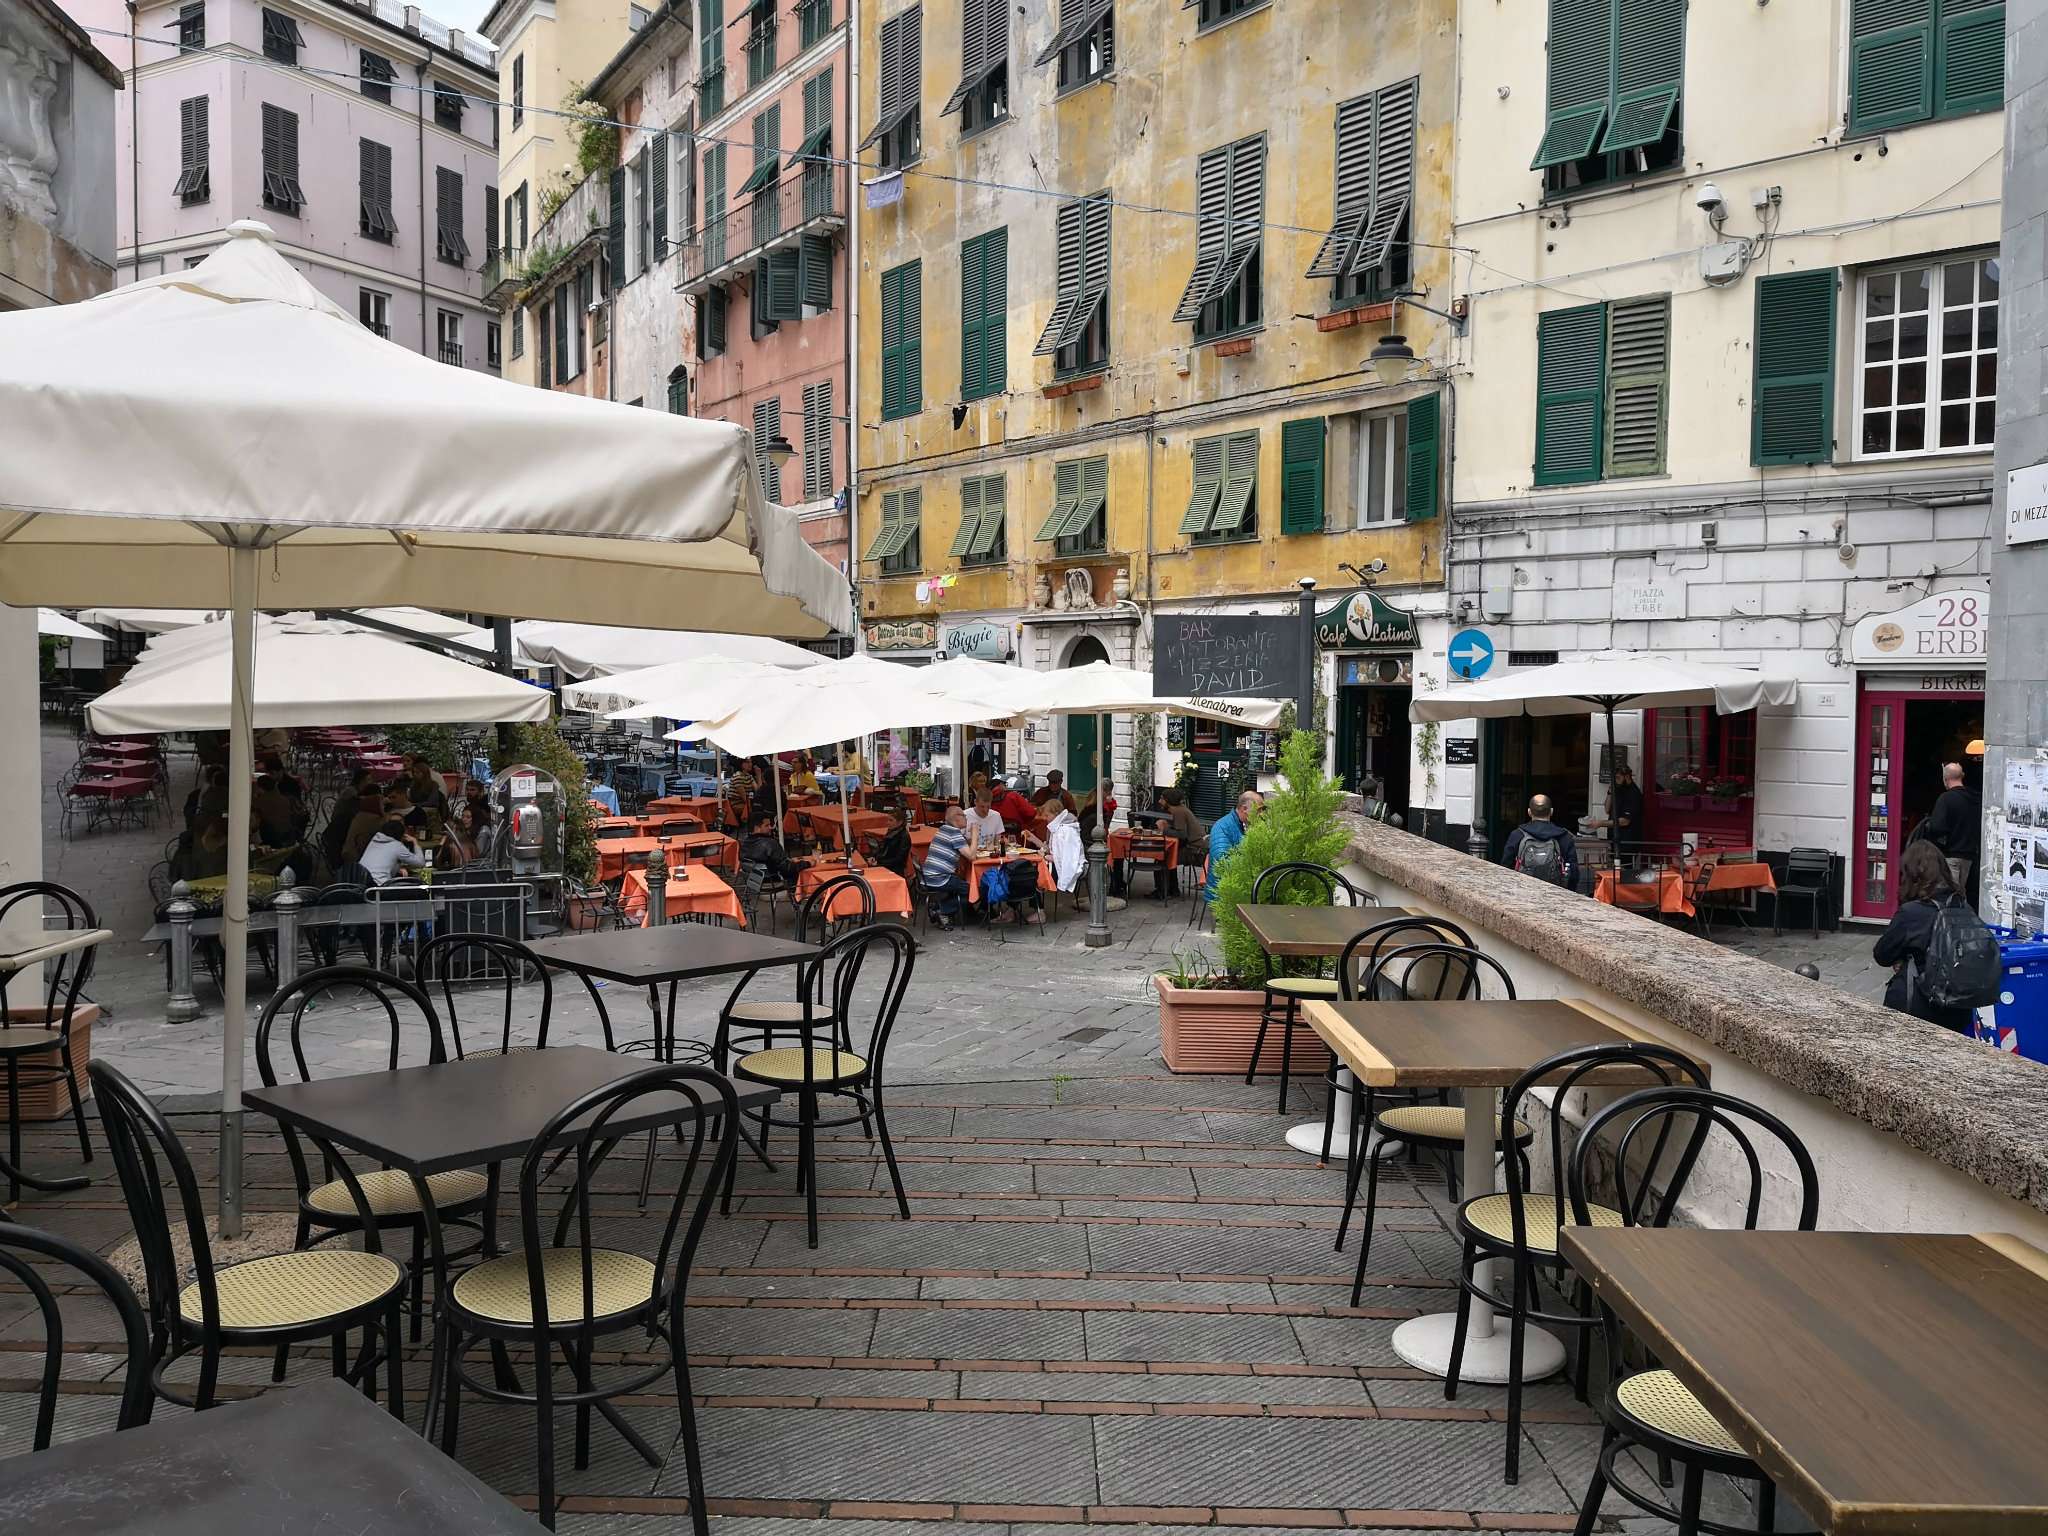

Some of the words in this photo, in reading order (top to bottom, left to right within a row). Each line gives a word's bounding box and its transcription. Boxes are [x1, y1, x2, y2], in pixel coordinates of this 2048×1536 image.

[2011, 508, 2021, 524] DI
[1633, 588, 1665, 598] PIAZZA
[1634, 604, 1663, 613] ERBE
[1937, 597, 1978, 627] 28
[948, 626, 993, 653] Biggie
[1179, 620, 1215, 641] BAR
[1370, 622, 1413, 642] Latino
[1191, 668, 1264, 692] DAVID
[1921, 676, 1985, 690] BIRRE
[1185, 696, 1244, 716] Menabrea
